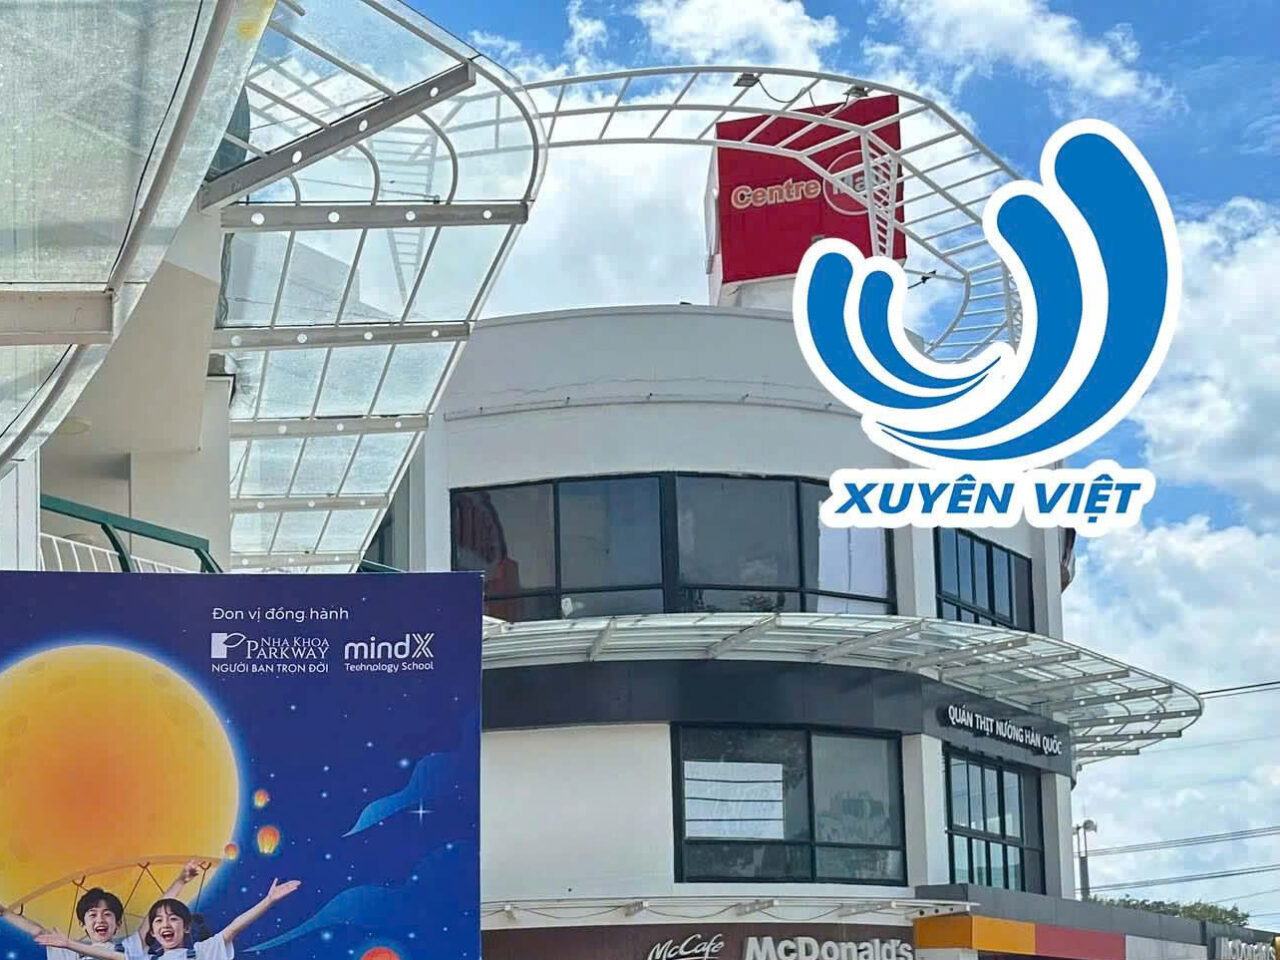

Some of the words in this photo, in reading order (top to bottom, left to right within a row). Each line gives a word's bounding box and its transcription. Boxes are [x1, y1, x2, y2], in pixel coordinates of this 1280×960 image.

[731, 177, 822, 209] Centre
[248, 606, 261, 623] vị
[309, 606, 349, 620] hành
[247, 640, 329, 660] PARKWAY
[261, 637, 290, 647] NHA
[293, 637, 330, 647] KHOA
[344, 633, 435, 660] mindX
[345, 661, 399, 673] Technology
[402, 661, 434, 671] School
[948, 705, 973, 728] QUÁN
[974, 714, 995, 736] THỊT
[1025, 727, 1041, 748] HÀN
[1042, 735, 1062, 755] QUỐC
